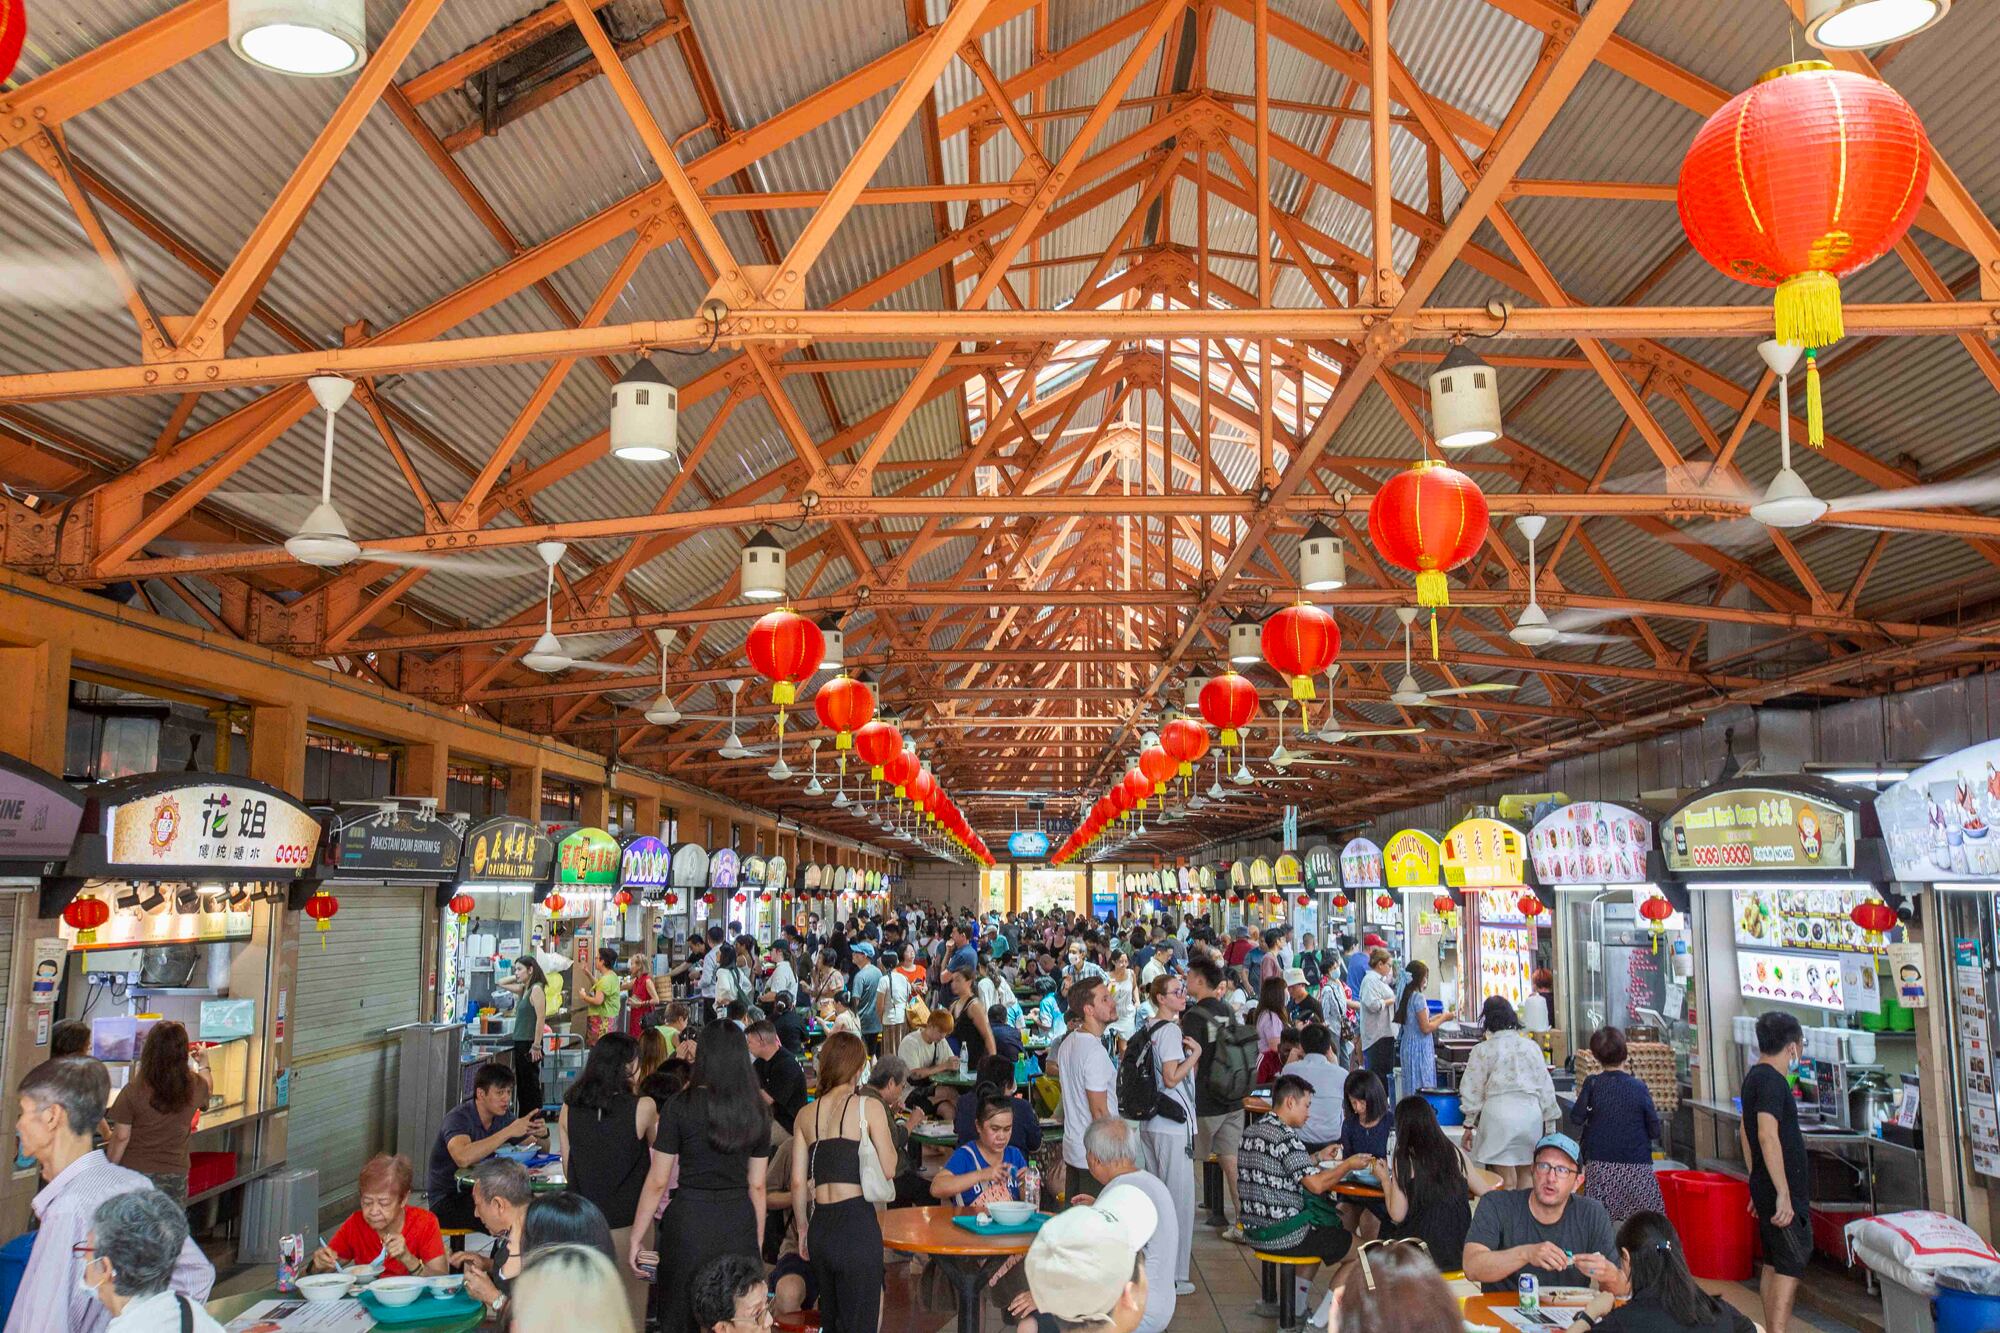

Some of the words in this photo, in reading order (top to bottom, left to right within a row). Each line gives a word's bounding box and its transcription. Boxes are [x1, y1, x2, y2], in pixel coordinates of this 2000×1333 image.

[0, 800, 25, 820] INE
[203, 793, 268, 839] 花姐
[370, 836, 400, 850] PAKISTANI
[400, 839, 414, 852] DUM
[413, 840, 434, 853] BIRYANI
[433, 841, 441, 854] SG
[43, 862, 55, 875] 67
[488, 863, 517, 875] ORIGINAL
